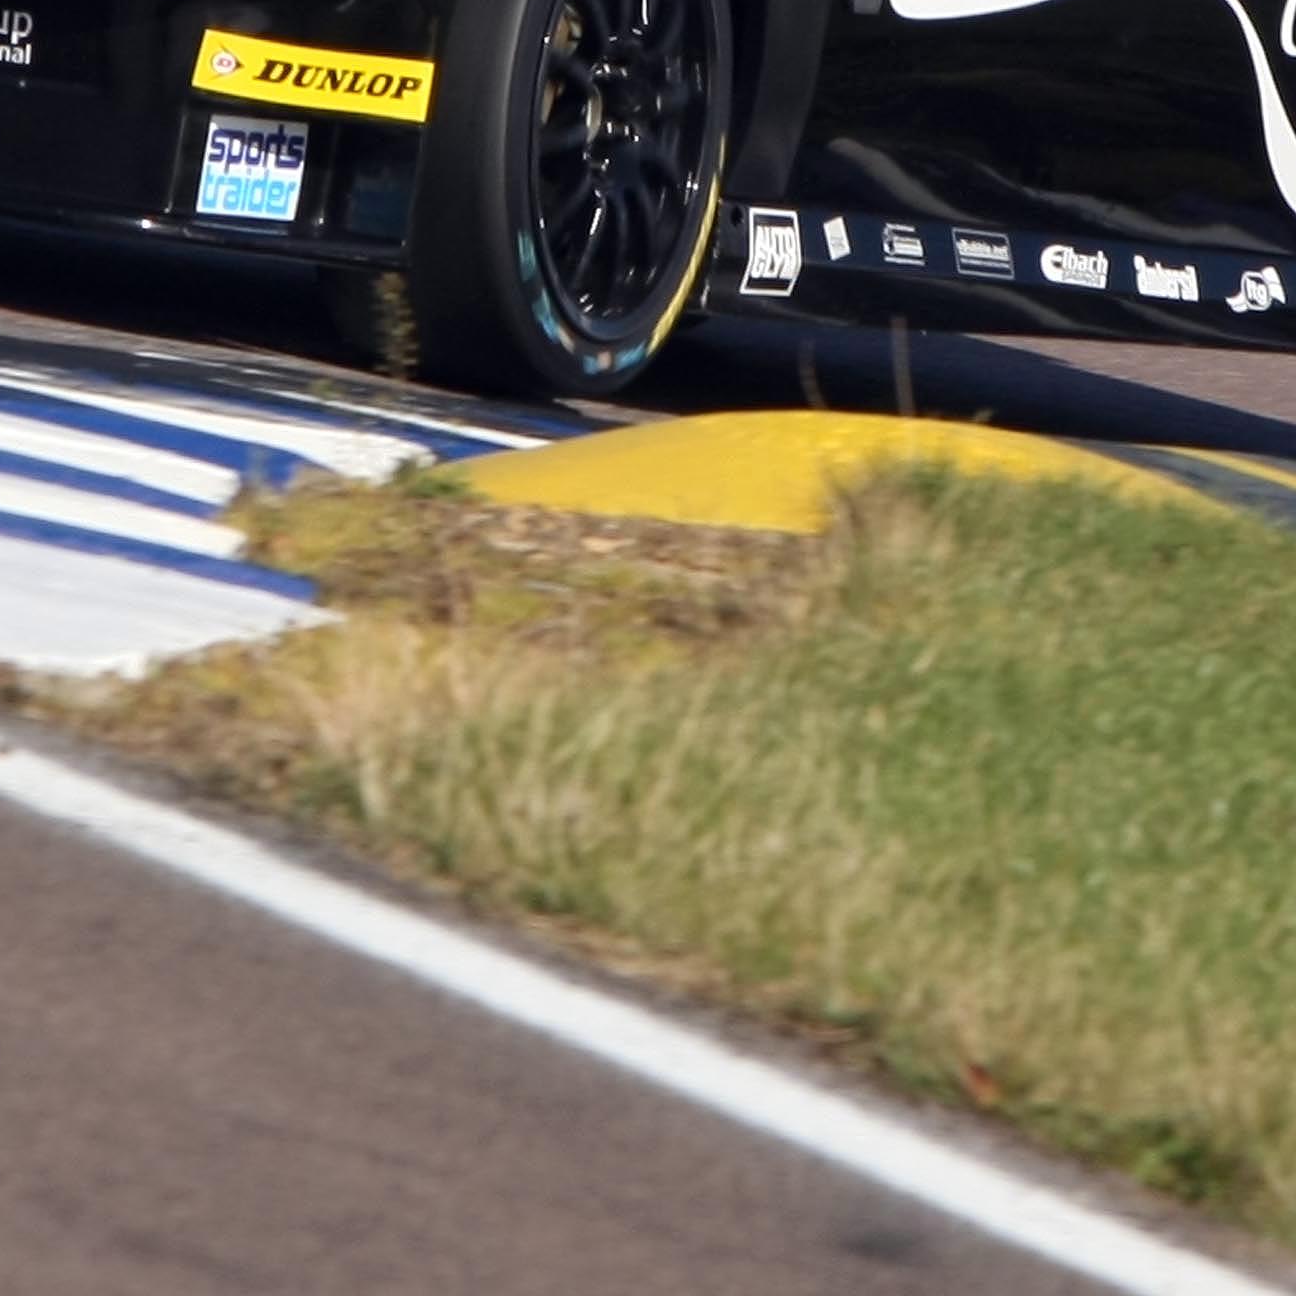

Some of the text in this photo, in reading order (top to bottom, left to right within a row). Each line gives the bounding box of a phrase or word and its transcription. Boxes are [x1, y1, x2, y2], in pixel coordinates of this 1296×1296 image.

[253, 57, 423, 102] DUNLOP
[207, 124, 306, 174] sports
[200, 166, 298, 214] traider
